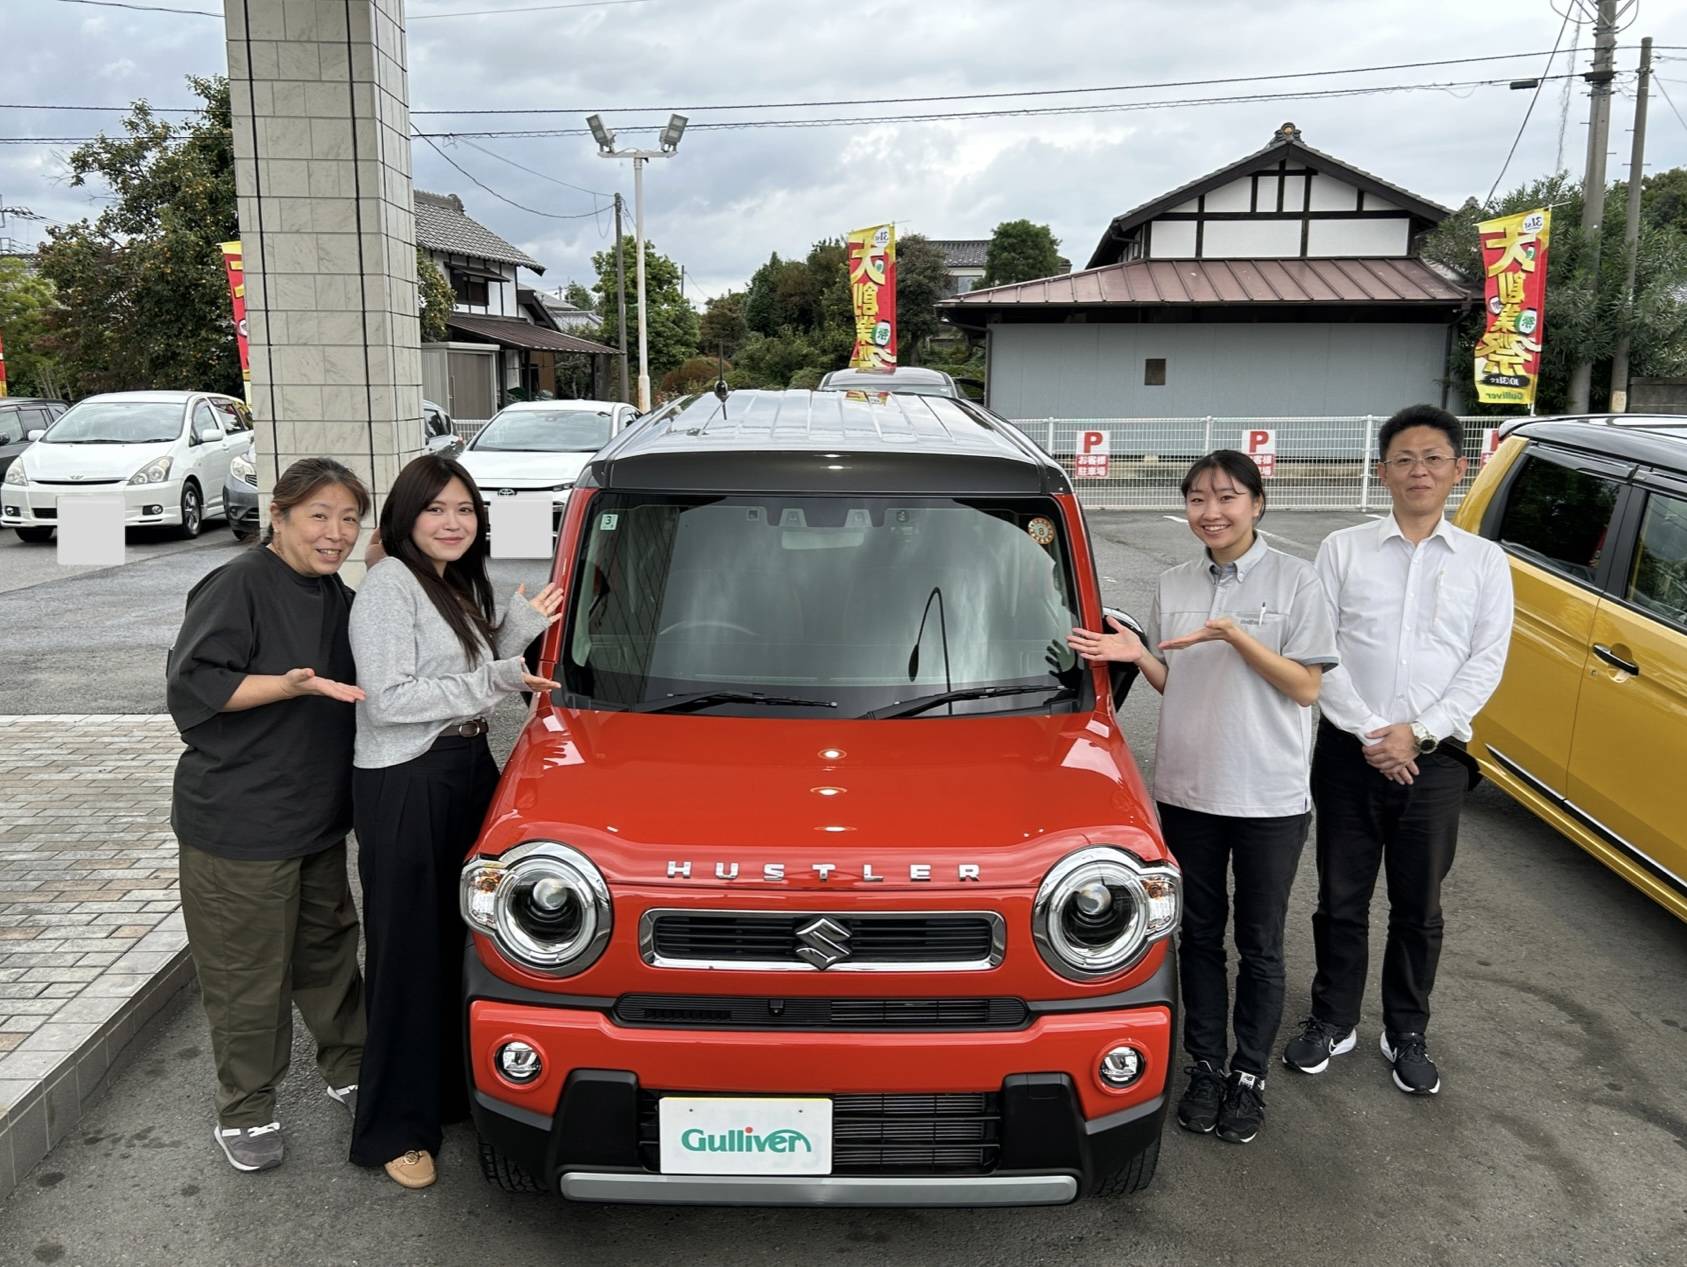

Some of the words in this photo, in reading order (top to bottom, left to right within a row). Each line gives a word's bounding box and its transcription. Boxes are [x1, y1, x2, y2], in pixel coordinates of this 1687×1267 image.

[1084, 431, 1103, 453] P
[1249, 431, 1269, 453] P
[1078, 455, 1106, 465] お客様
[1078, 466, 1106, 476] 駐車場
[667, 860, 981, 882] HUSTLER
[681, 1126, 812, 1153] Gulliver
